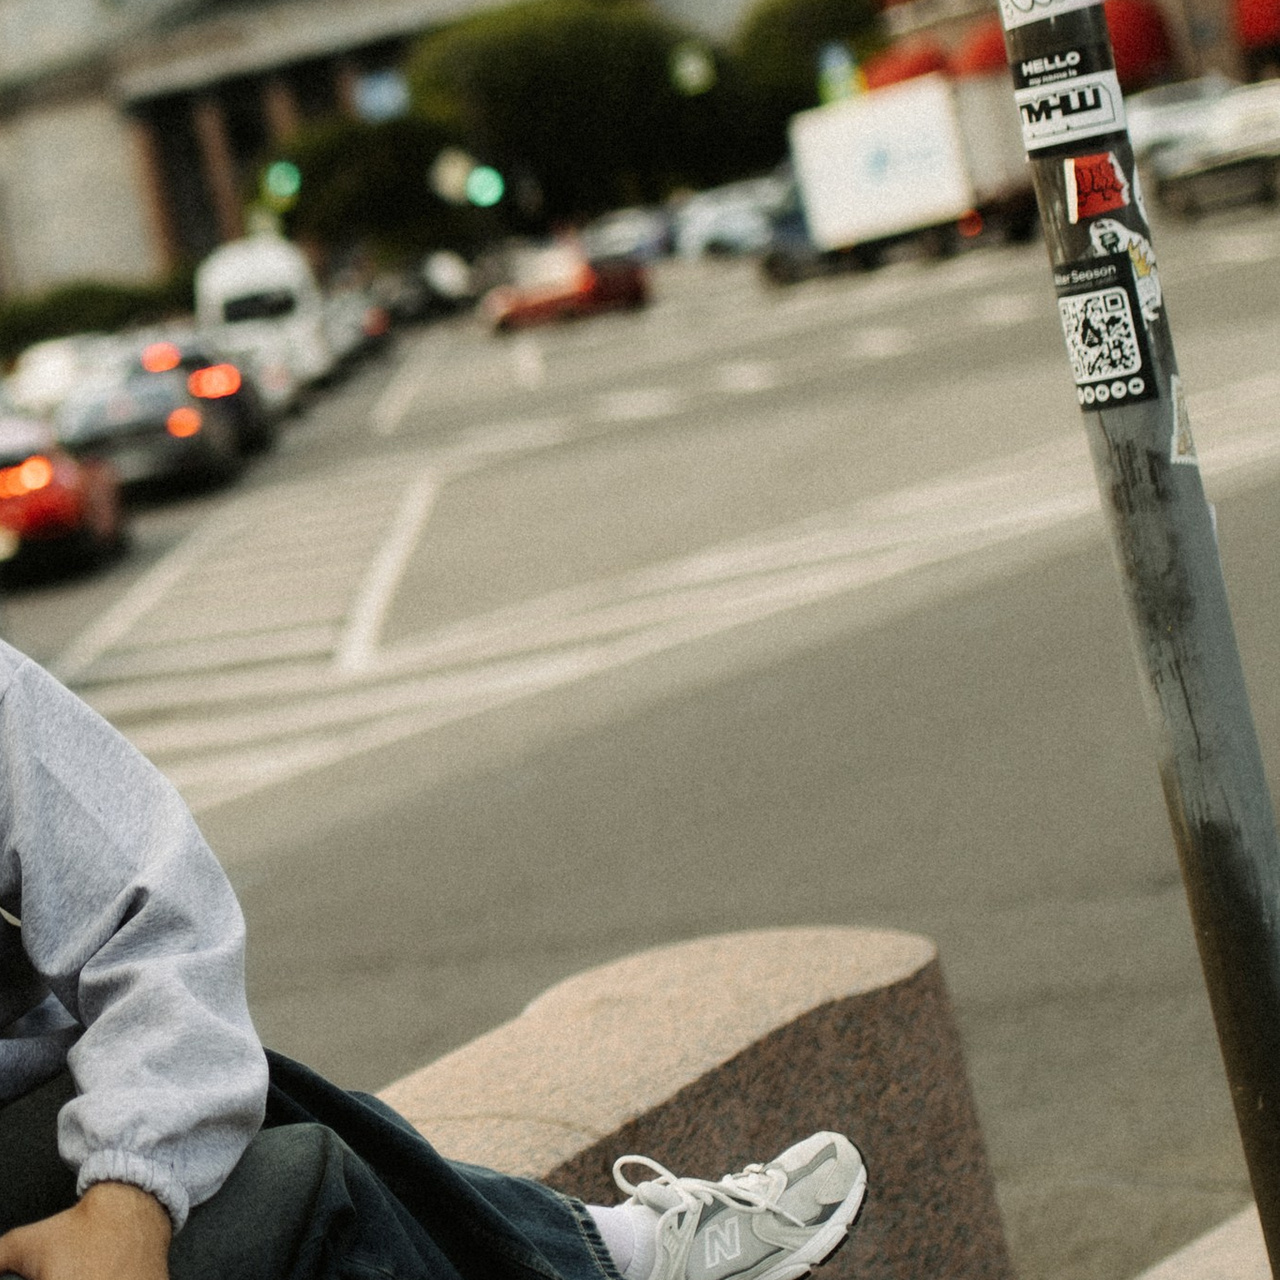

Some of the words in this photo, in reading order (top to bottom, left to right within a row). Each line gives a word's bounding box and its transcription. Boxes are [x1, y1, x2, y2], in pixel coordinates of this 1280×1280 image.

[1022, 51, 1080, 77] HELLO
[1042, 71, 1068, 83] name
[704, 1216, 741, 1269] N
